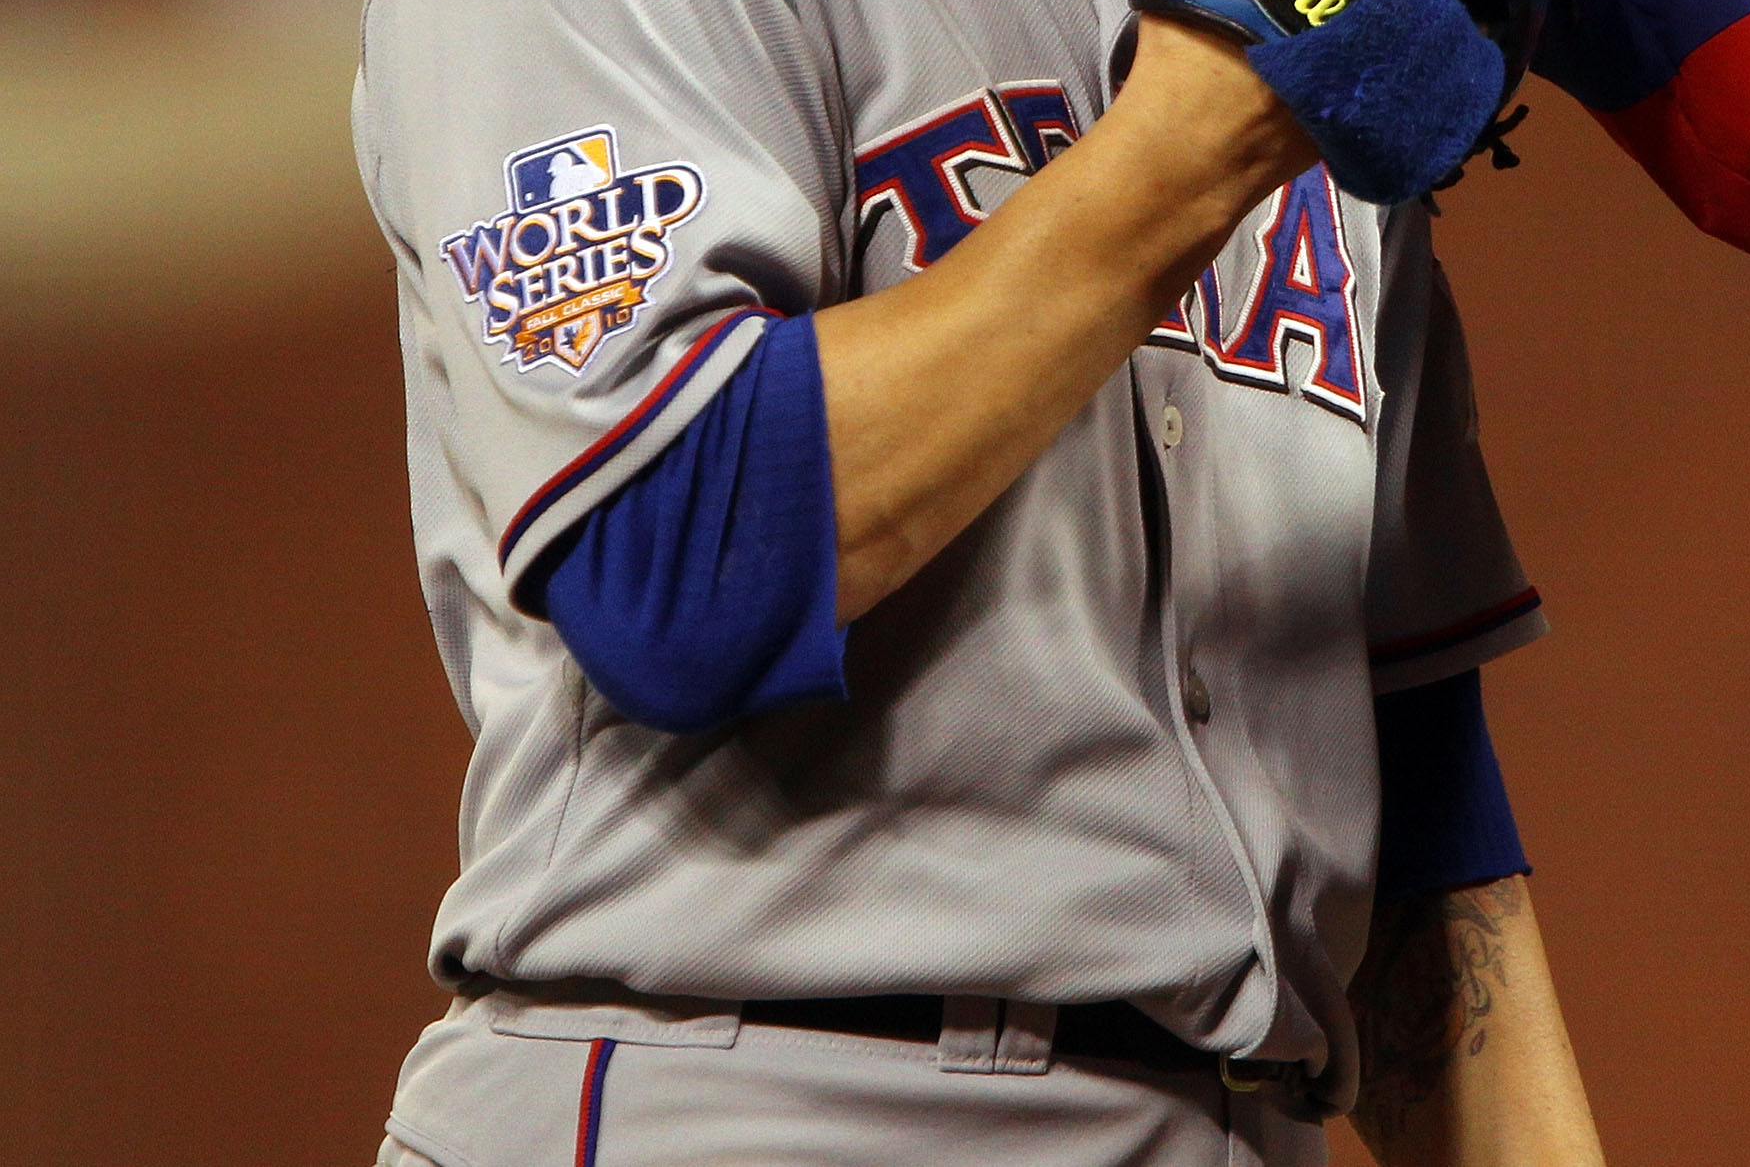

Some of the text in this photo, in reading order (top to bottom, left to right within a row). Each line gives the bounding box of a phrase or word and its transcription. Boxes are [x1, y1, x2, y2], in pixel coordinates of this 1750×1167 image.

[447, 167, 700, 294] WORLD
[487, 224, 667, 334] SERIES
[526, 286, 626, 331] FALL CLASSIC
[523, 308, 632, 361] 20 10
